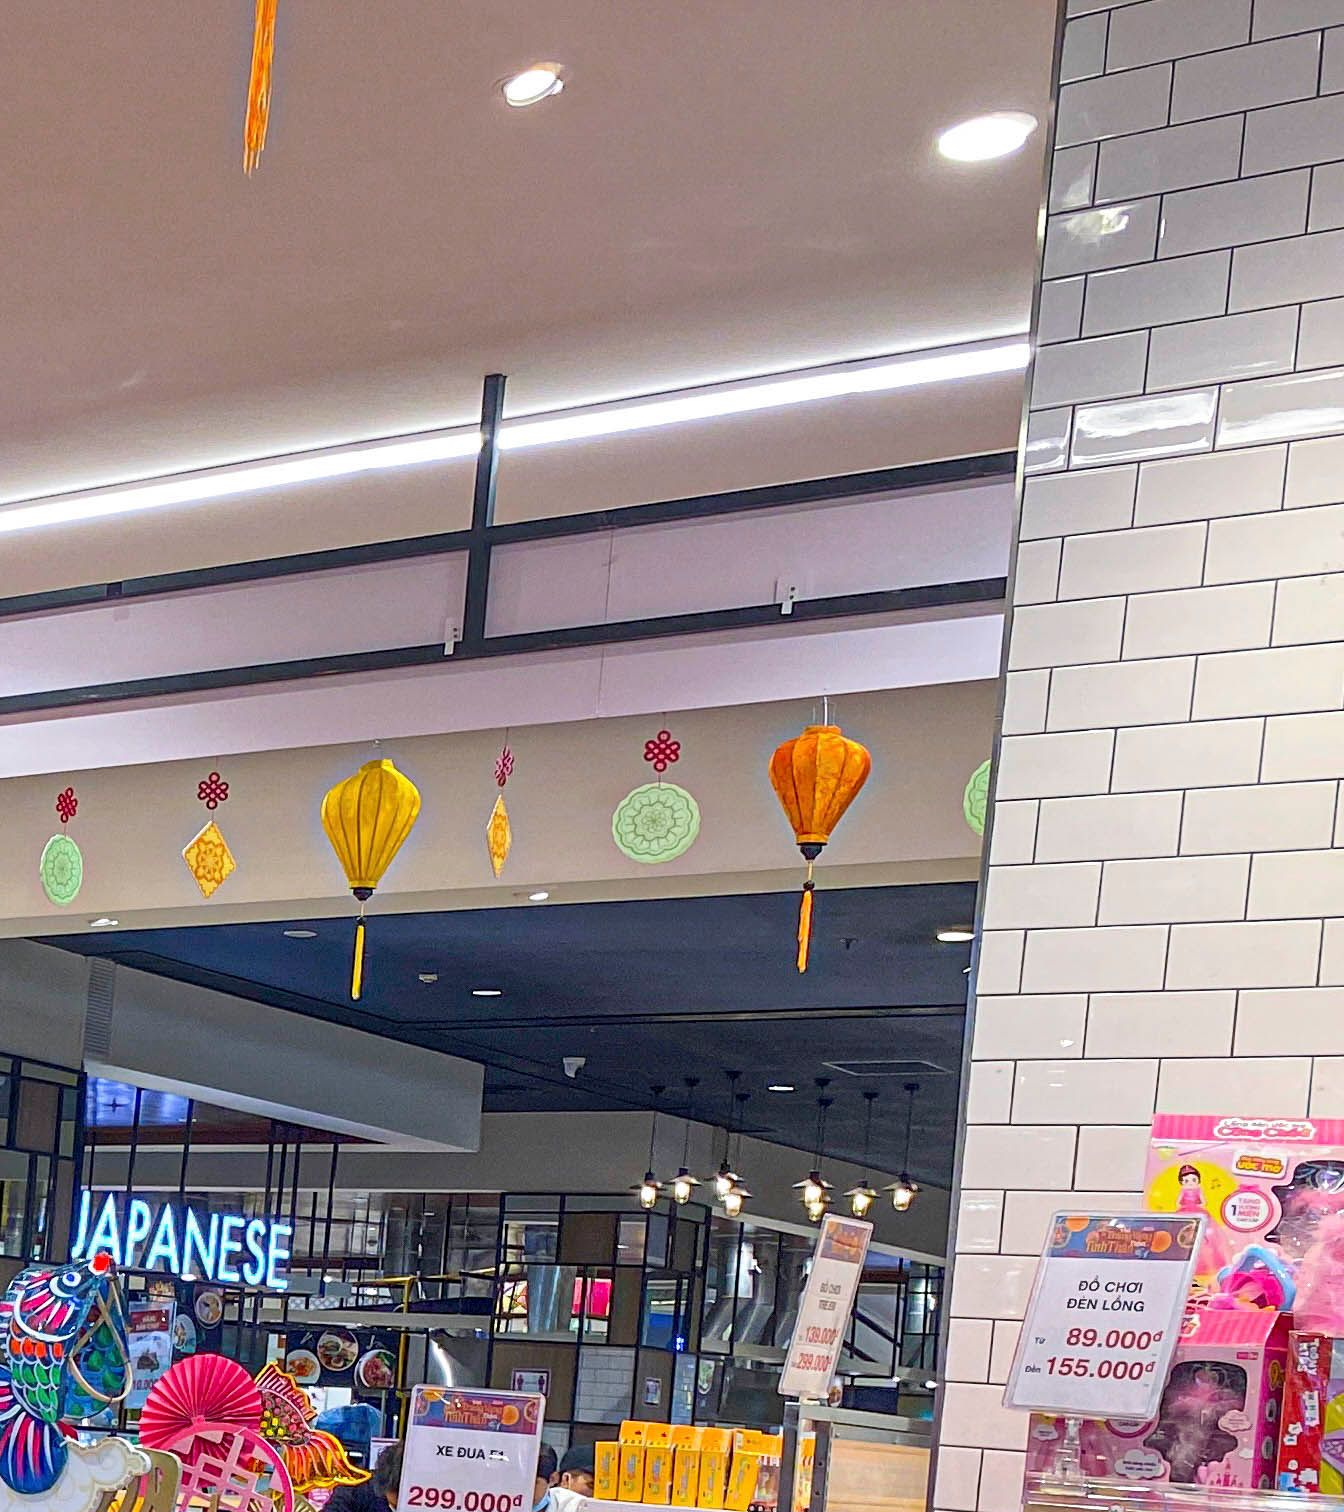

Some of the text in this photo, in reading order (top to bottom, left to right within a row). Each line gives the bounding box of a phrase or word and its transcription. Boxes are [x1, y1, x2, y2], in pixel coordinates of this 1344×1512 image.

[72, 1189, 292, 1292] JAPANESE
[1104, 1281, 1144, 1294] CHƠI
[1066, 1296, 1098, 1310] ĐÈN
[1066, 1328, 1164, 1350] 89.000đ
[1046, 1356, 1155, 1381] 155.000đ
[436, 1445, 486, 1460] XE ĐUA
